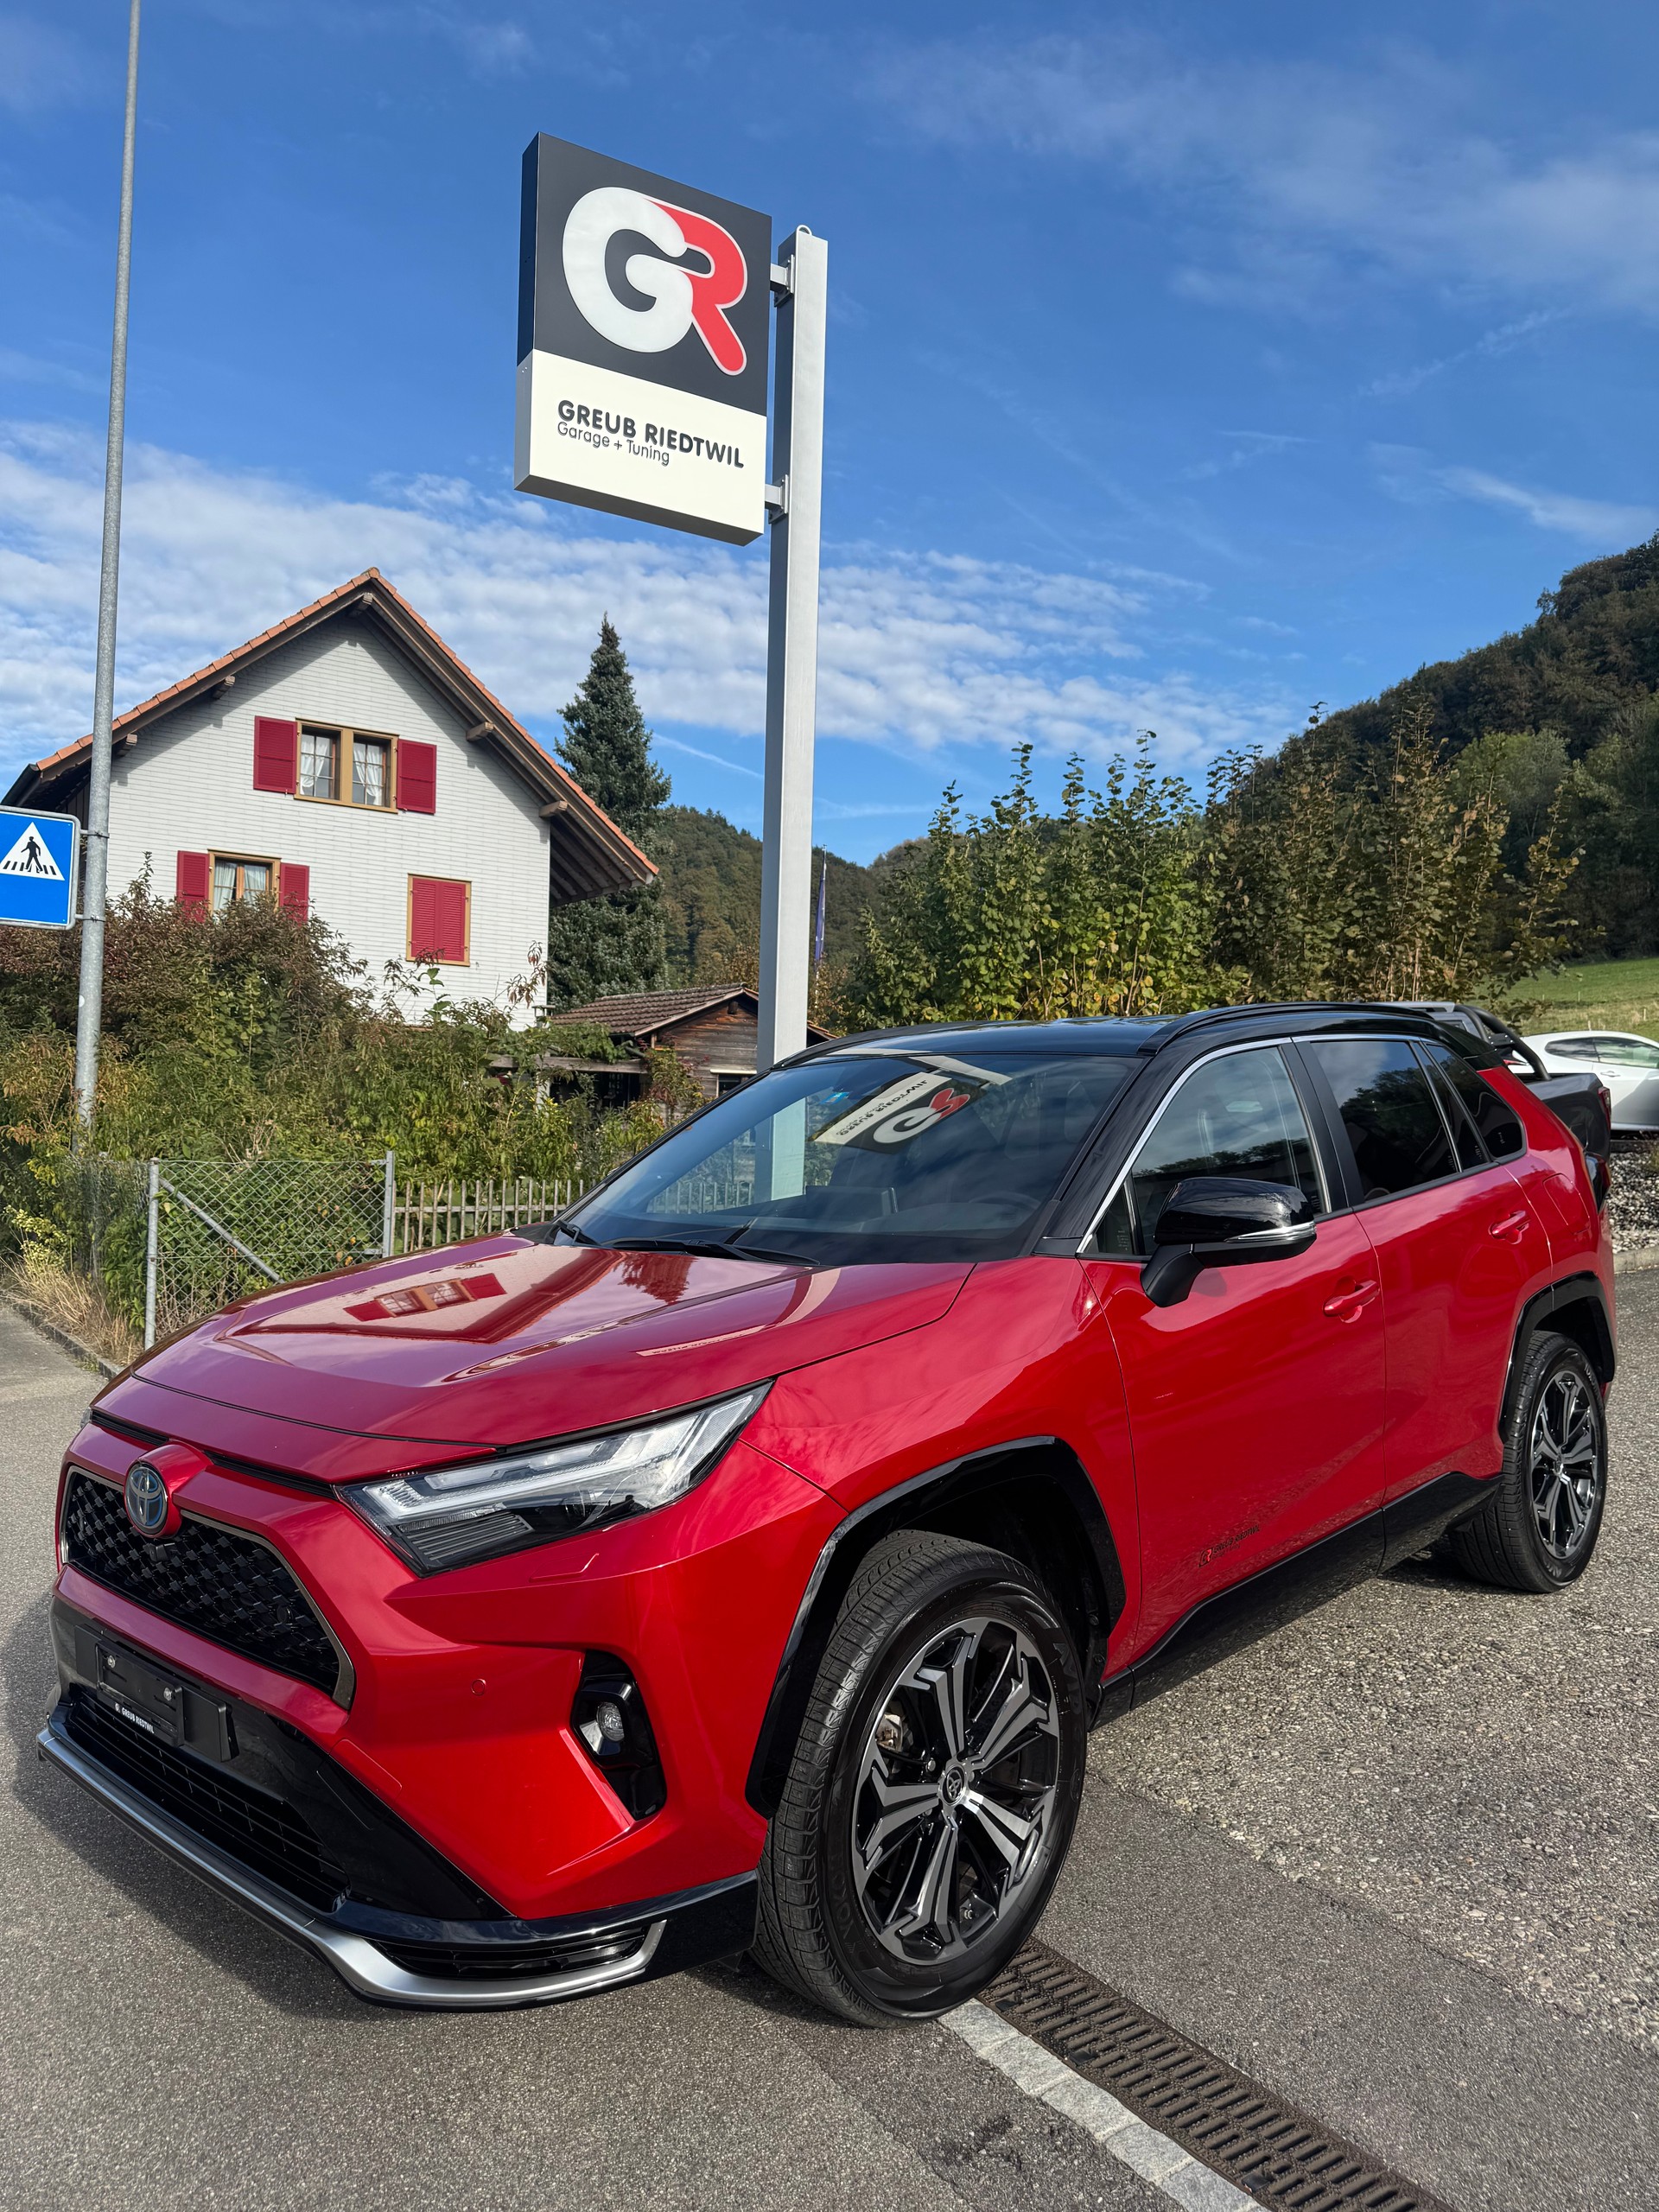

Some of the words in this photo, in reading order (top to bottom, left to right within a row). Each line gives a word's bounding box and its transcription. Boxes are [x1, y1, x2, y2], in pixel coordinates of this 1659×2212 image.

[563, 187, 747, 376] GR
[557, 400, 636, 438] GREUB
[645, 422, 744, 469] RIEDTWIL
[557, 421, 610, 451] Garage
[613, 439, 623, 450] +
[626, 439, 670, 467] Tuning
[122, 1707, 136, 1722] GREUB
